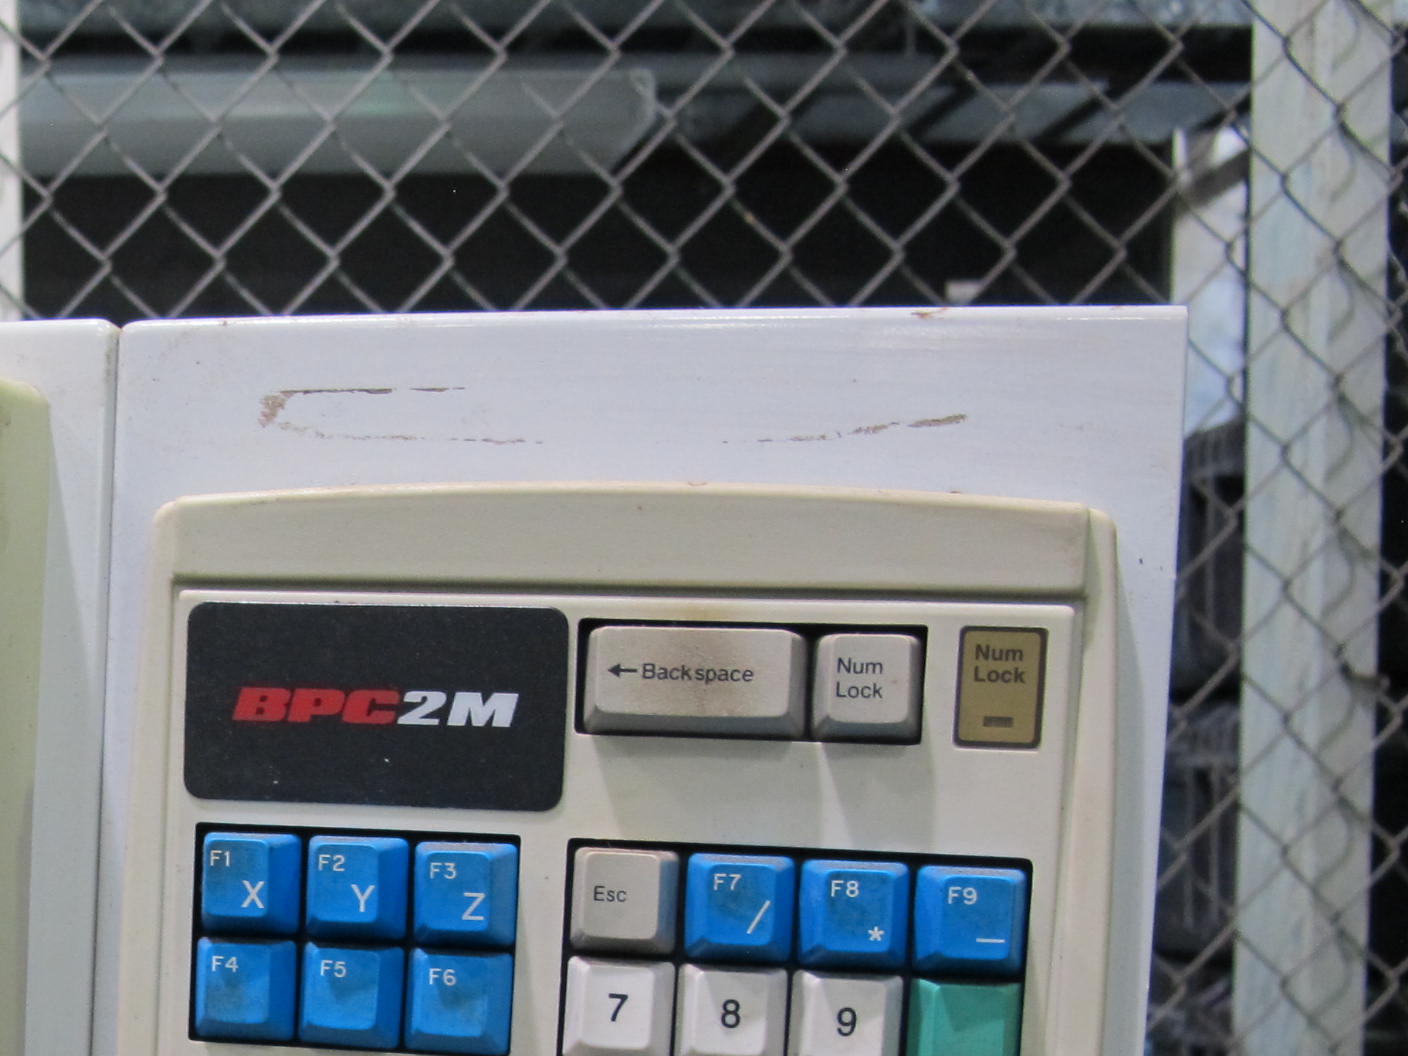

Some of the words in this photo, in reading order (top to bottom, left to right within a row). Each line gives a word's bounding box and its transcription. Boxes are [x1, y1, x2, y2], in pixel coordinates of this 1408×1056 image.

[975, 643, 1024, 662] Num
[641, 662, 755, 684] Backspace
[836, 657, 884, 676] Num
[974, 665, 1026, 685] Lock
[835, 680, 883, 700] Lock
[232, 686, 519, 728] BPC2M
[209, 850, 232, 867] F1
[317, 854, 346, 872] F2
[429, 862, 457, 880] F3
[712, 872, 742, 891] F7
[830, 879, 860, 899] F8
[241, 880, 265, 909] X
[350, 884, 376, 913] Y
[592, 885, 627, 903] Esc
[947, 886, 978, 905] F9
[461, 891, 486, 921] Z
[210, 955, 239, 973] F4
[319, 959, 347, 978] F5
[428, 968, 457, 987] F6
[607, 992, 629, 1023] 7
[720, 998, 741, 1029] 8
[836, 1007, 857, 1037] 9
